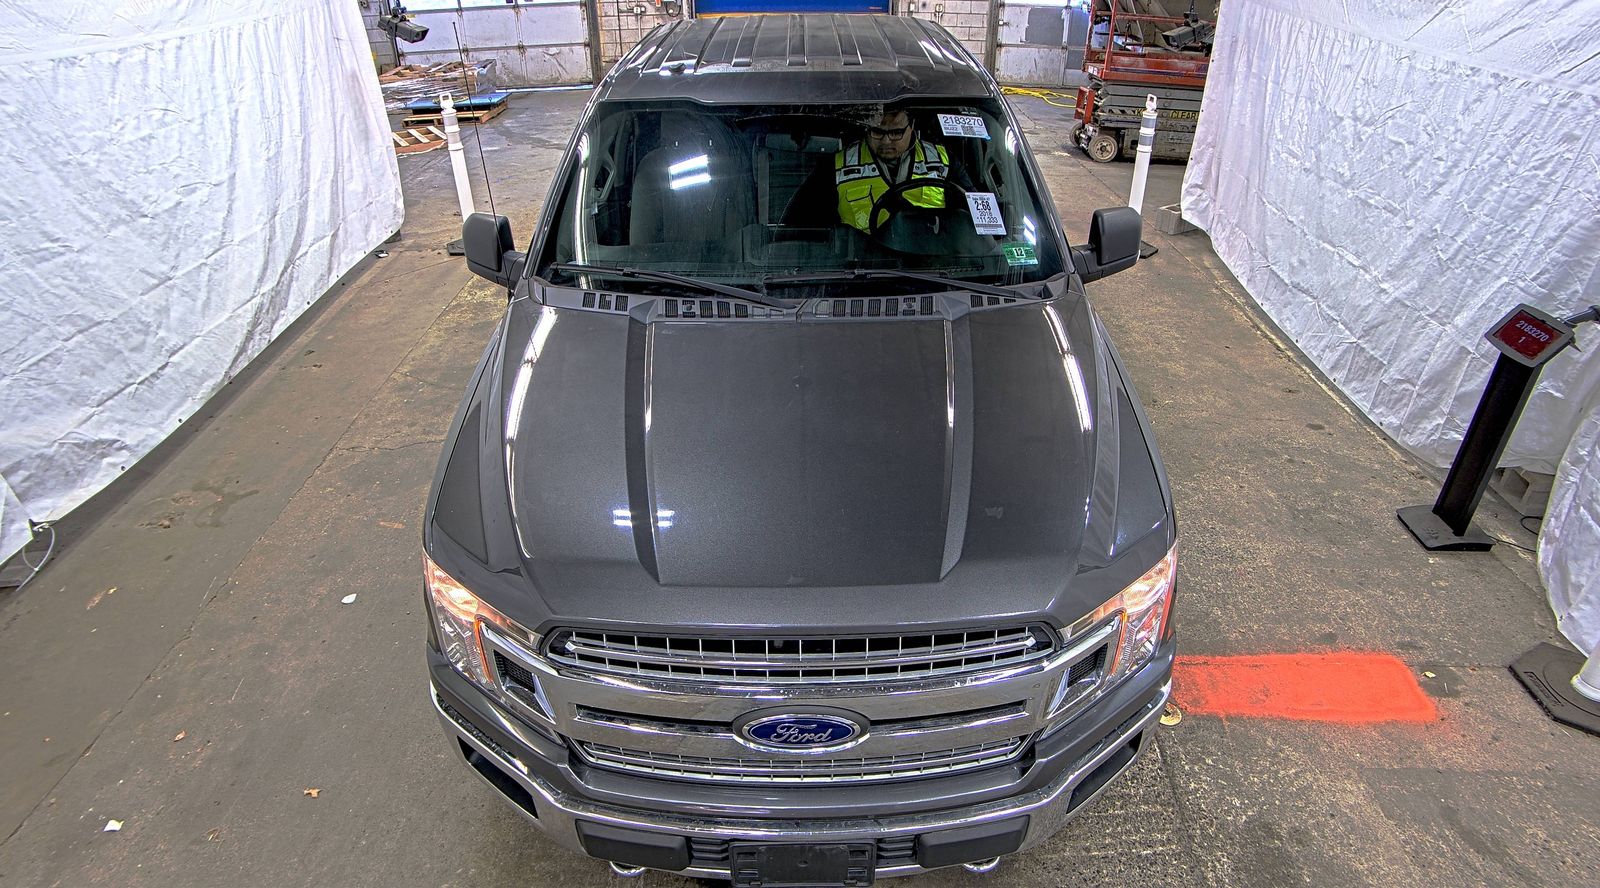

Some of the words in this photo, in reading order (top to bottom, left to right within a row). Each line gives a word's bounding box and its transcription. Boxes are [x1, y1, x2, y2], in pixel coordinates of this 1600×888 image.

[942, 115, 983, 127] 2183270
[1014, 247, 1025, 256] 12
[1515, 320, 1550, 342] 2183270
[770, 723, 832, 742] Ford
